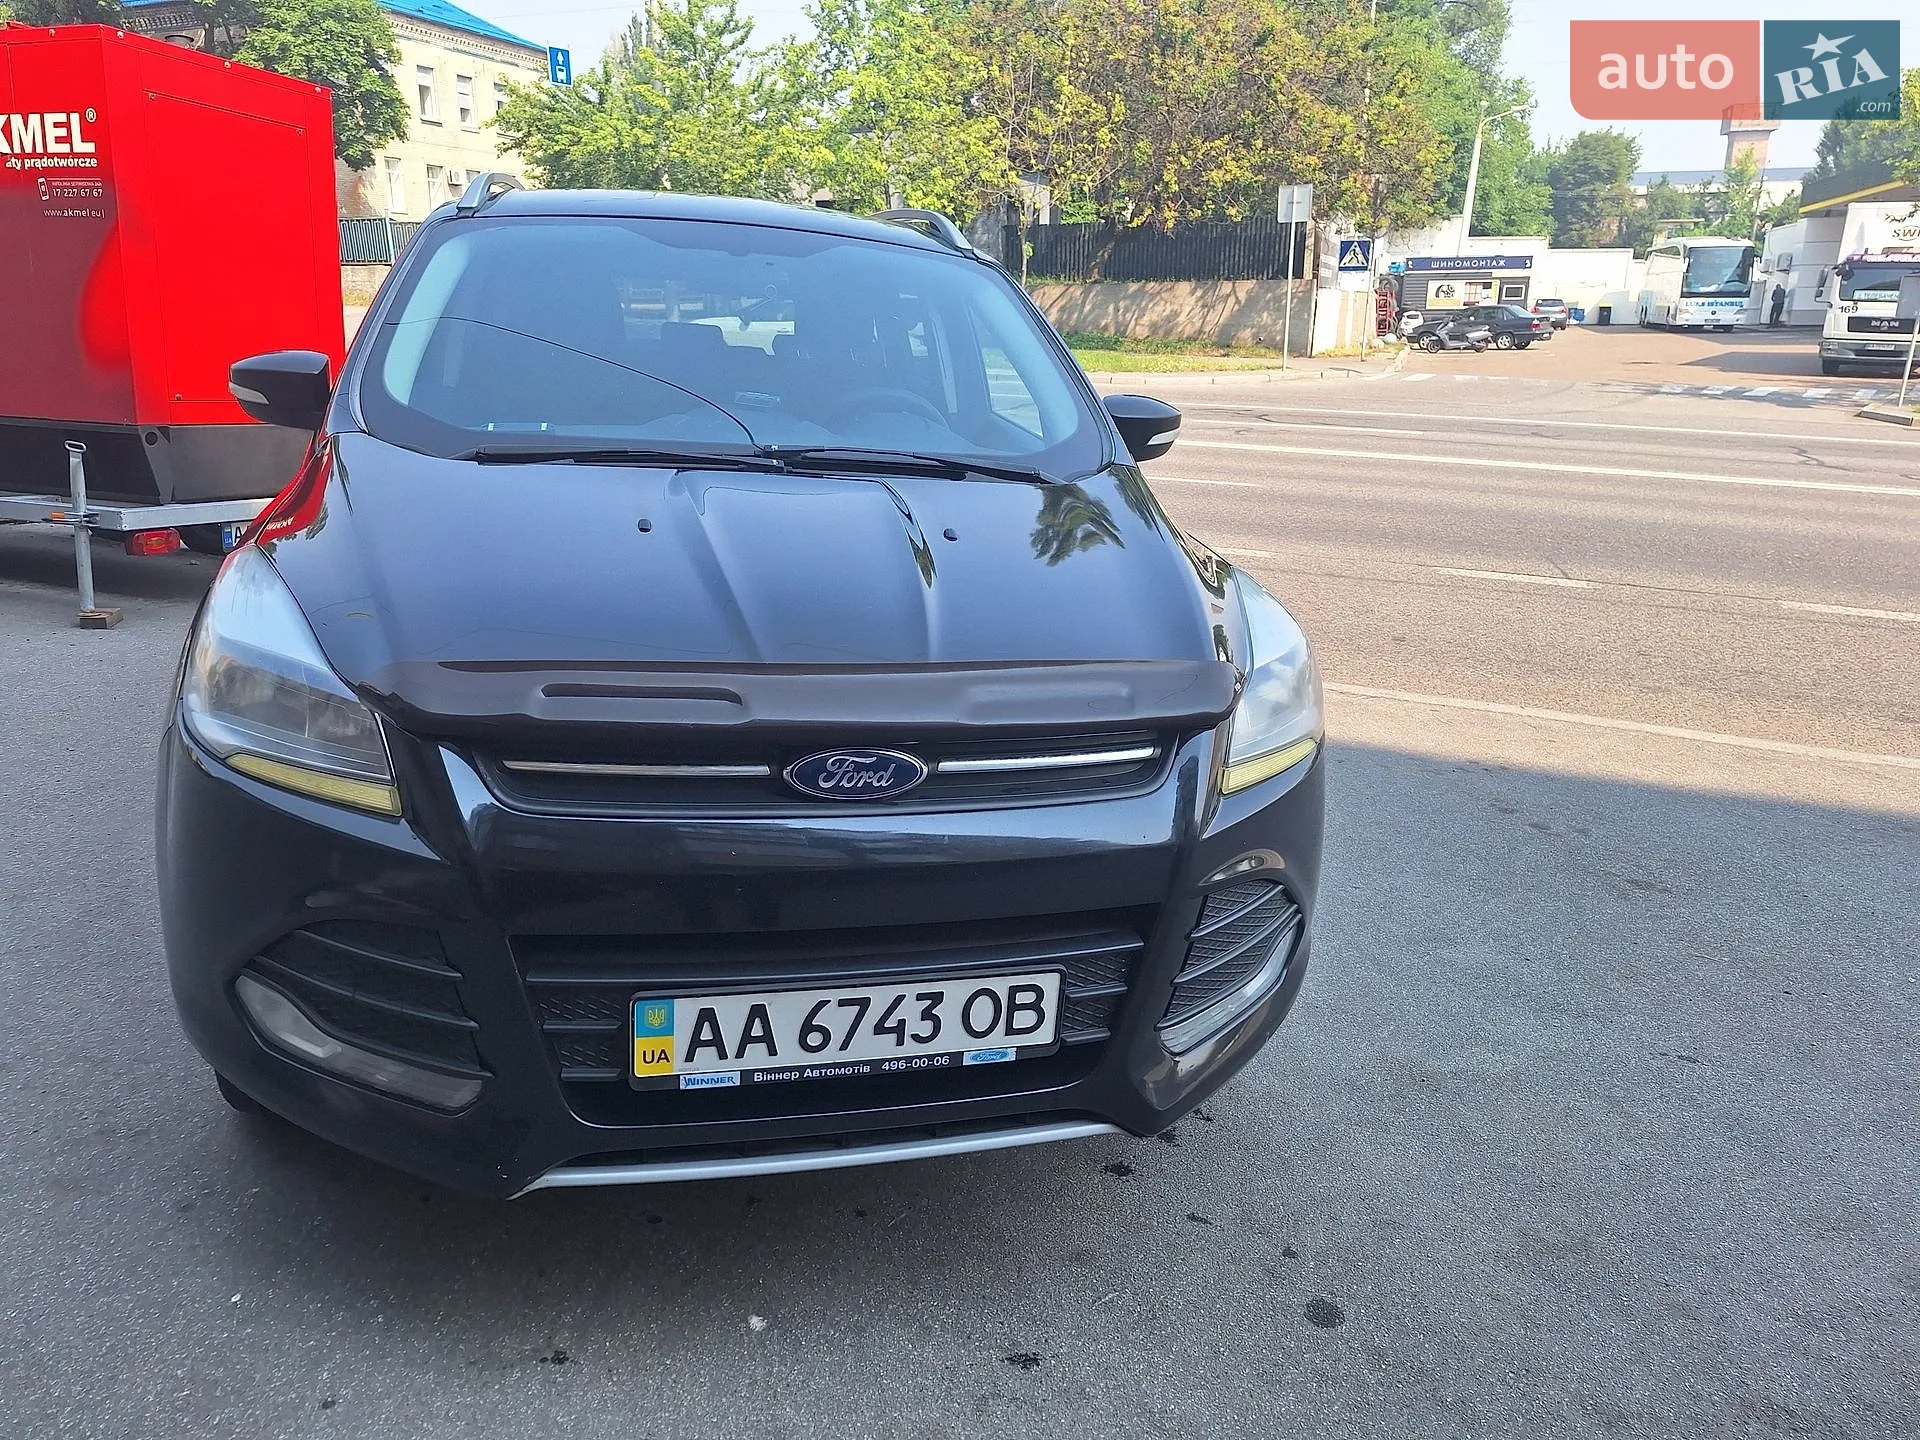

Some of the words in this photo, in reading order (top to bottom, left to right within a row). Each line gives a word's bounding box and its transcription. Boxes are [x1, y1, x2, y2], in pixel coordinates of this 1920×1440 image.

[24, 155, 97, 170] prądotwórcze
[52, 188, 61, 197] 17
[63, 188, 78, 197] 227
[80, 188, 90, 197] 67
[92, 188, 103, 197] 67
[1431, 259, 1506, 268] ШИНОМОНТАЖ
[1839, 305, 1859, 314] 169
[817, 755, 896, 789] Ford
[683, 1003, 779, 1063] AA
[798, 991, 945, 1053] 6743
[961, 983, 1047, 1040] OB
[641, 1049, 671, 1065] UA
[754, 1069, 799, 1082] Віннер
[803, 1062, 871, 1078] Автомотів
[881, 1055, 950, 1072] 496-00-06
[683, 1075, 736, 1088] WINNER
